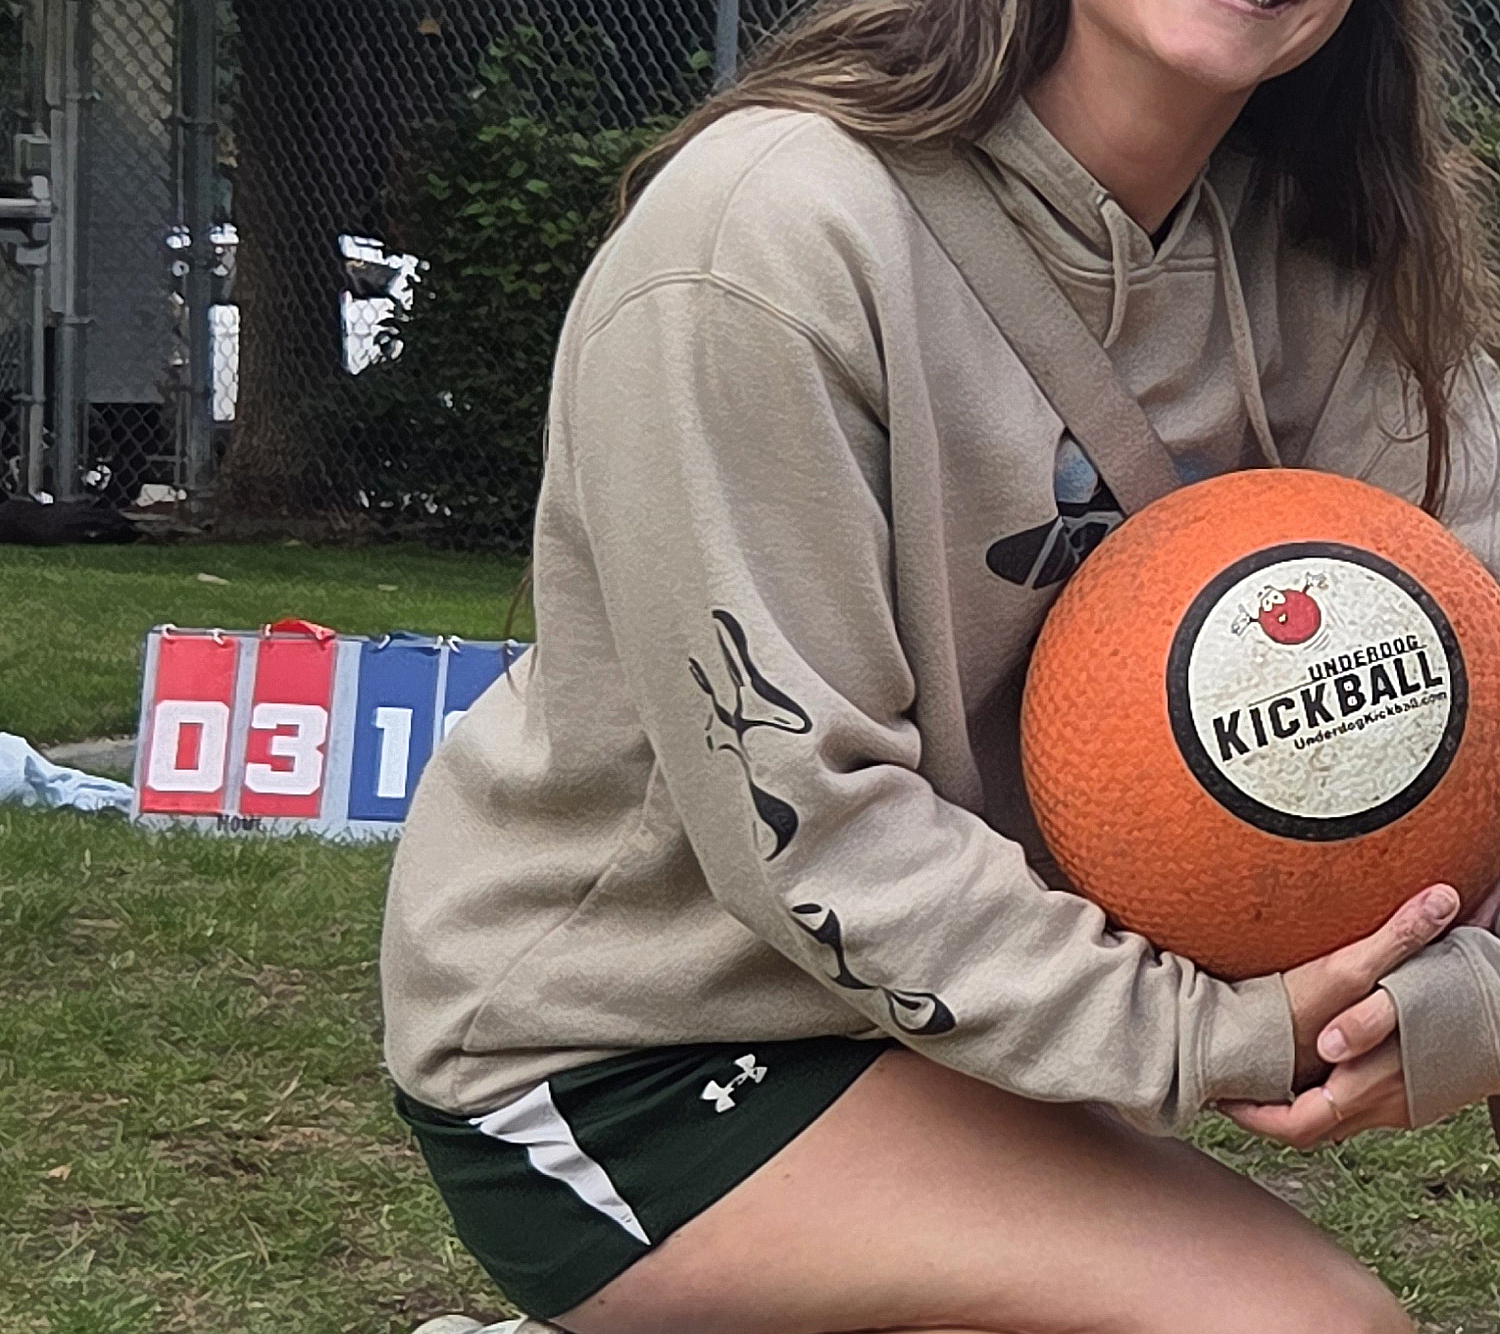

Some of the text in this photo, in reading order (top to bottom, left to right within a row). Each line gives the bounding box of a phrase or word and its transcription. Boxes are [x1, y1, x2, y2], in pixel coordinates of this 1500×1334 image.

[1308, 634, 1424, 682] UNDERDOG
[1212, 650, 1444, 763] KICKBALL
[1294, 691, 1448, 751] UnderdogKickball.com
